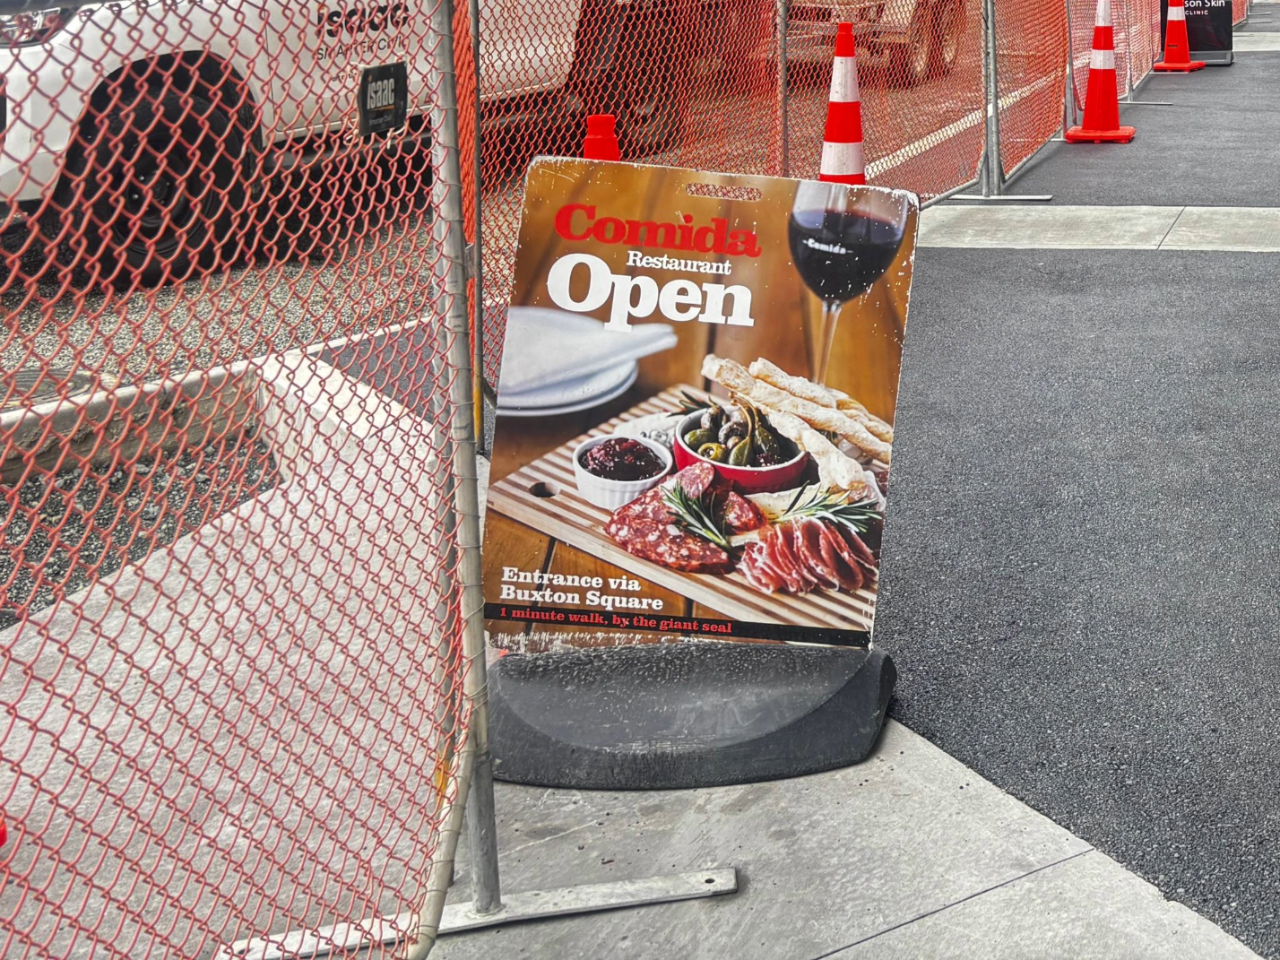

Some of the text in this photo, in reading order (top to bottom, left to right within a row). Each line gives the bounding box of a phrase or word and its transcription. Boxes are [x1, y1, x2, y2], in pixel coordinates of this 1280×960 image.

[366, 77, 395, 110] isaac
[554, 203, 763, 258] Comida
[626, 250, 732, 276] Restaurant
[547, 253, 754, 333] Open
[501, 566, 642, 591] Entrance via
[500, 585, 664, 612] Buxton Square
[500, 607, 732, 634] 1 minute walk, by the giant seal
